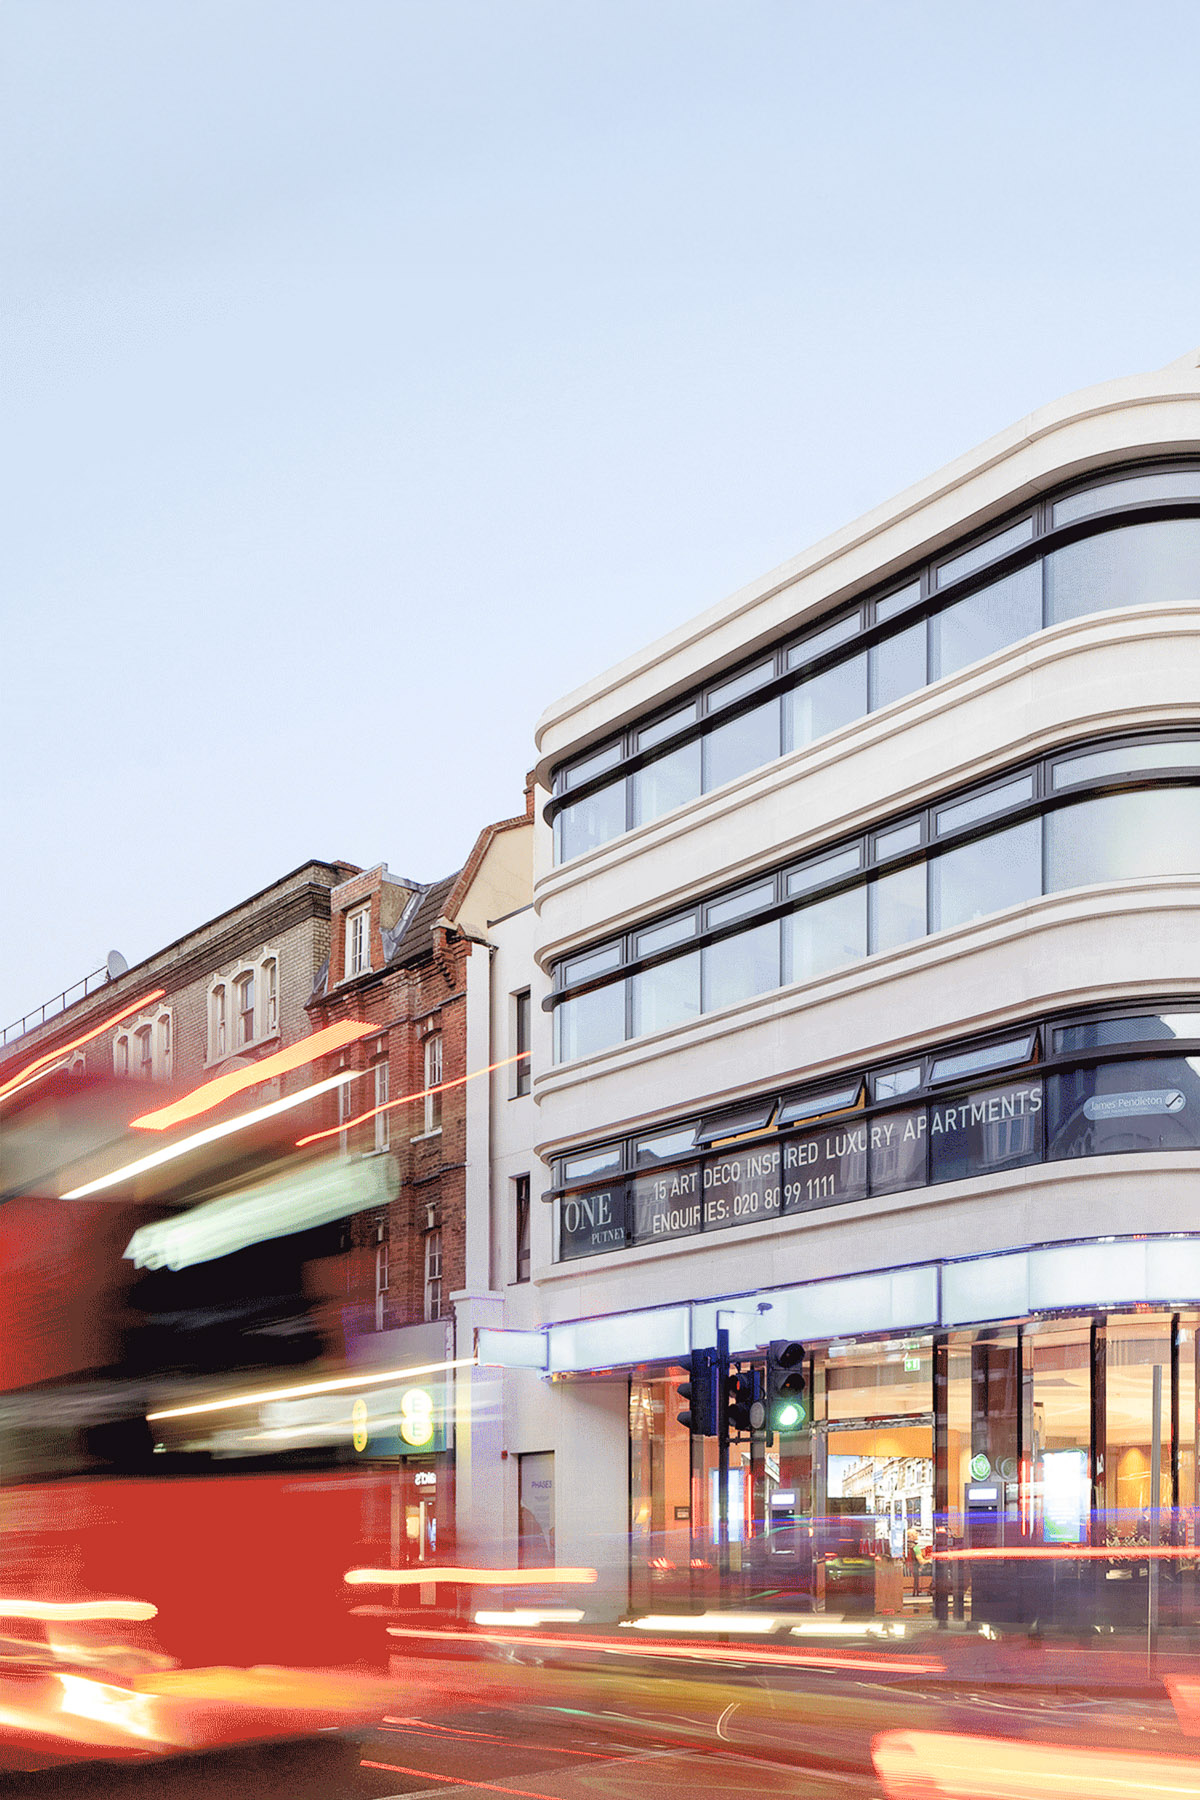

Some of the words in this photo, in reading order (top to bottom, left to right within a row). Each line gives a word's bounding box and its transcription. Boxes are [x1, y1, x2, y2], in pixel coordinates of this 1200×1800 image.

[1089, 1100, 1116, 1112] James
[1118, 1096, 1163, 1108] Pendleton
[653, 1181, 667, 1201] 15
[670, 1172, 698, 1198] ART
[703, 1162, 741, 1189] DECO
[747, 1141, 819, 1179] INSPIRED
[826, 1123, 894, 1160] LUXURY
[903, 1087, 1043, 1142] APARTMENTS
[564, 1193, 612, 1233] ONE
[653, 1200, 730, 1234] ENQUIRIES:
[733, 1194, 759, 1216] 020
[764, 1182, 801, 1210] 8099
[806, 1174, 836, 1199] 1111
[591, 1227, 625, 1246] PUTNEY
